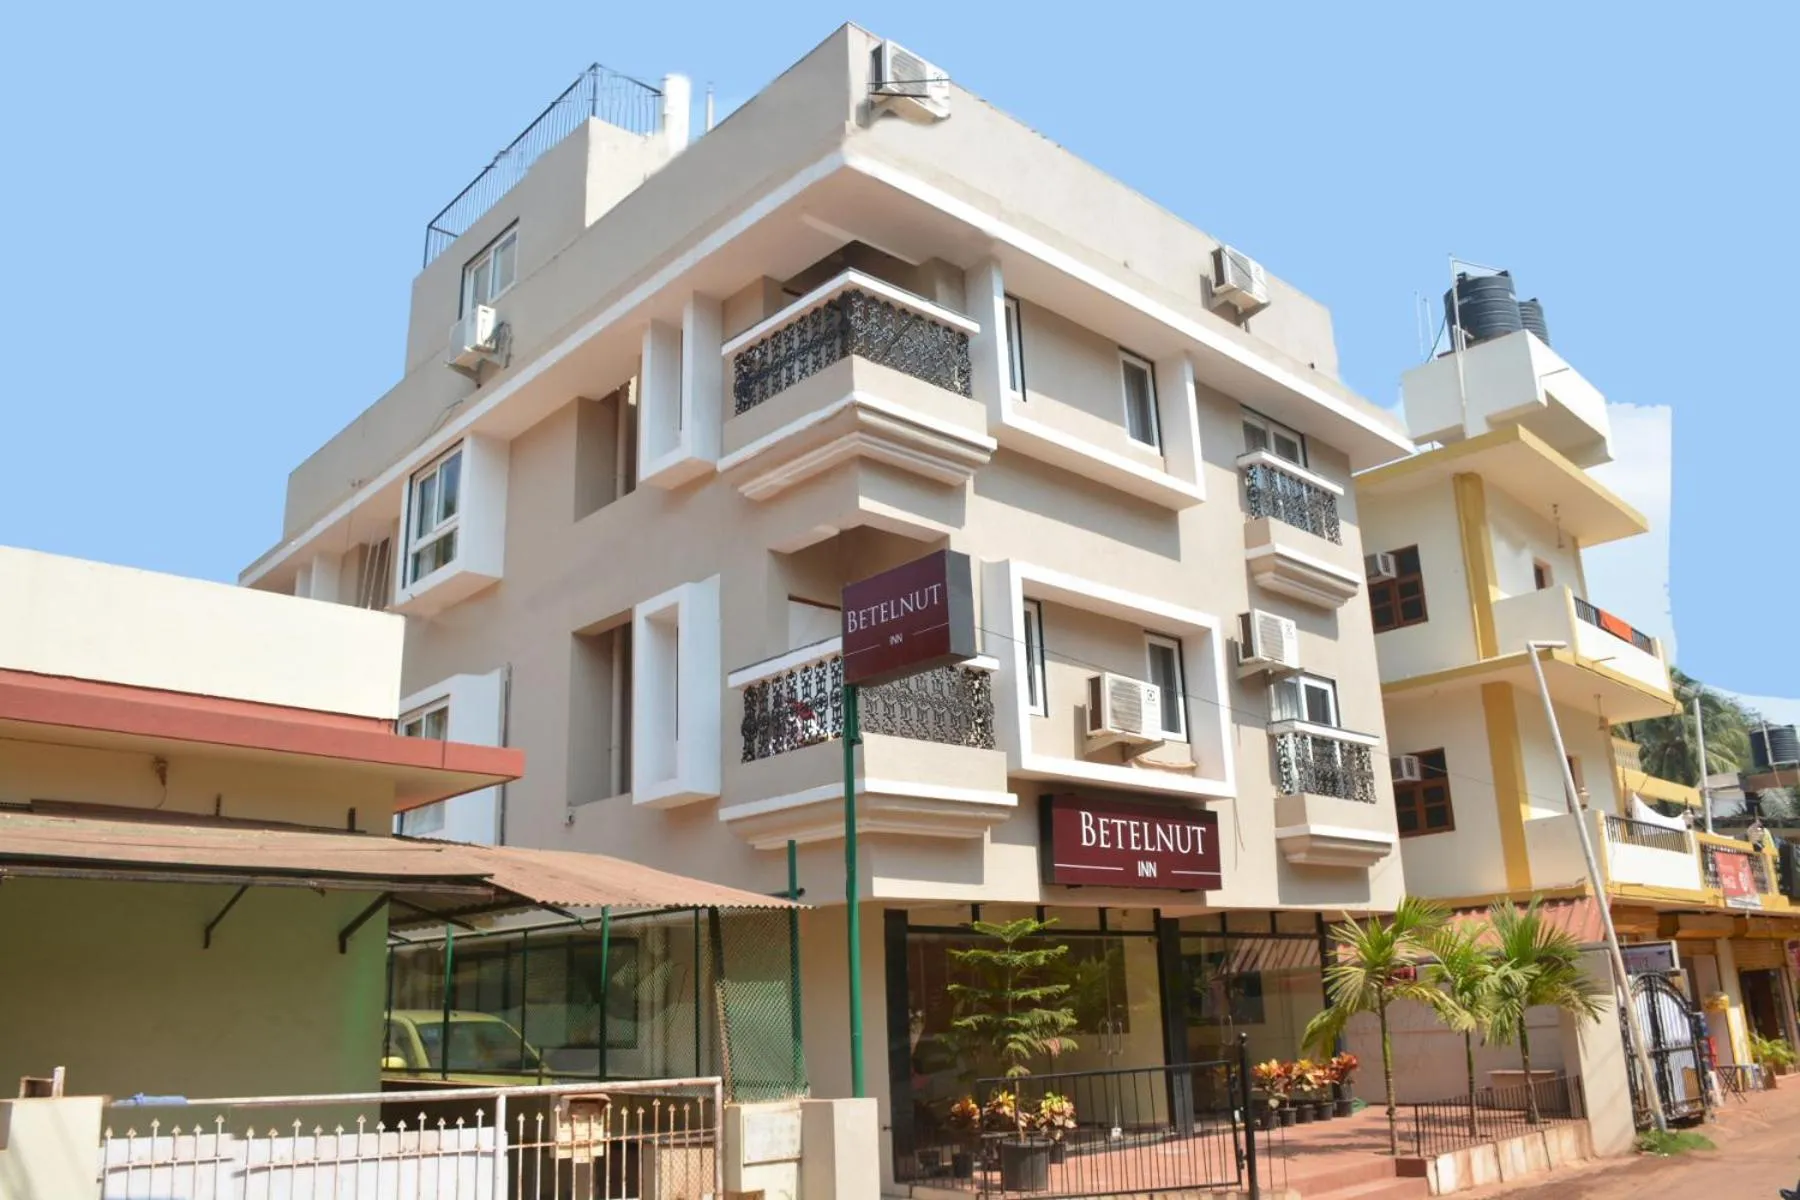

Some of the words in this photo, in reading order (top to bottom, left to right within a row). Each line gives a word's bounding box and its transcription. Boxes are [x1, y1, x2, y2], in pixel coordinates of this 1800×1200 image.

[847, 583, 941, 633] BETELNUT
[889, 633, 903, 645] INN
[1080, 811, 1206, 855] BETELNUT
[1138, 860, 1157, 878] INN
